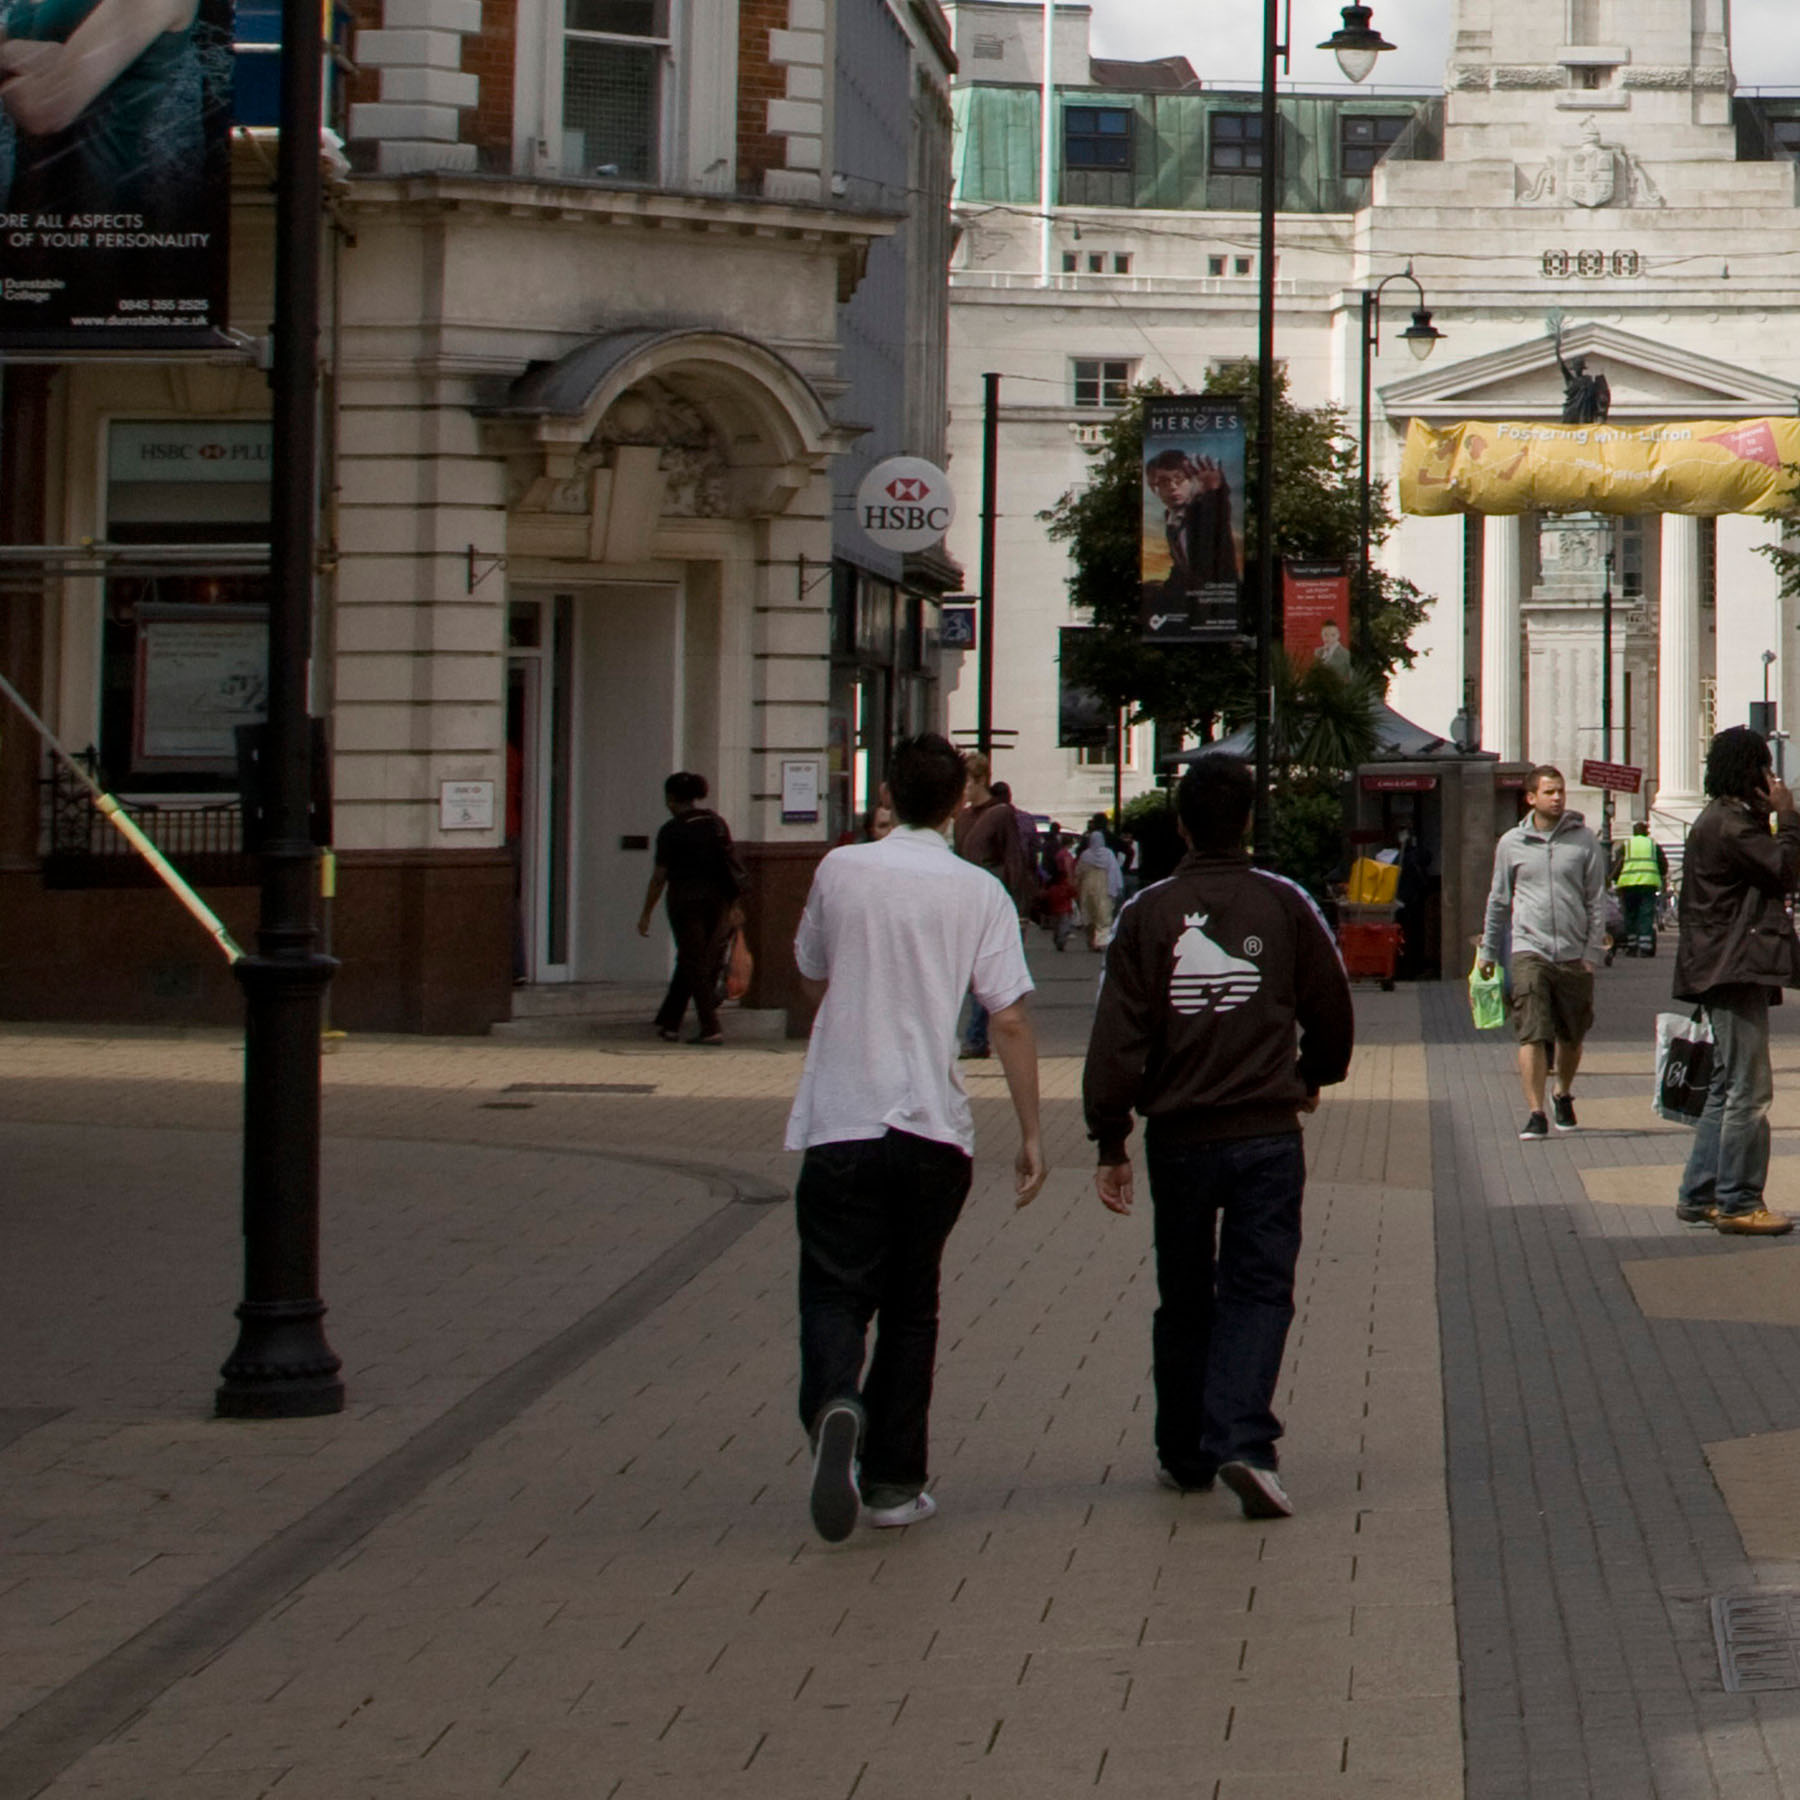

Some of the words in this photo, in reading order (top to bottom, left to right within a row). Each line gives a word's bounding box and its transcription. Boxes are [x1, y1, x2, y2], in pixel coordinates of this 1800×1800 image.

[35, 214, 63, 228] ALL
[69, 214, 144, 228] ASPECTS
[9, 233, 34, 247] OF
[41, 233, 89, 247] YOUR
[96, 233, 210, 247] PERSONALITY
[4, 278, 66, 289] Dunstable
[4, 290, 51, 303] College
[1497, 423, 1588, 444] Fostering
[141, 444, 192, 460] HSBC
[864, 506, 950, 531] HSBC
